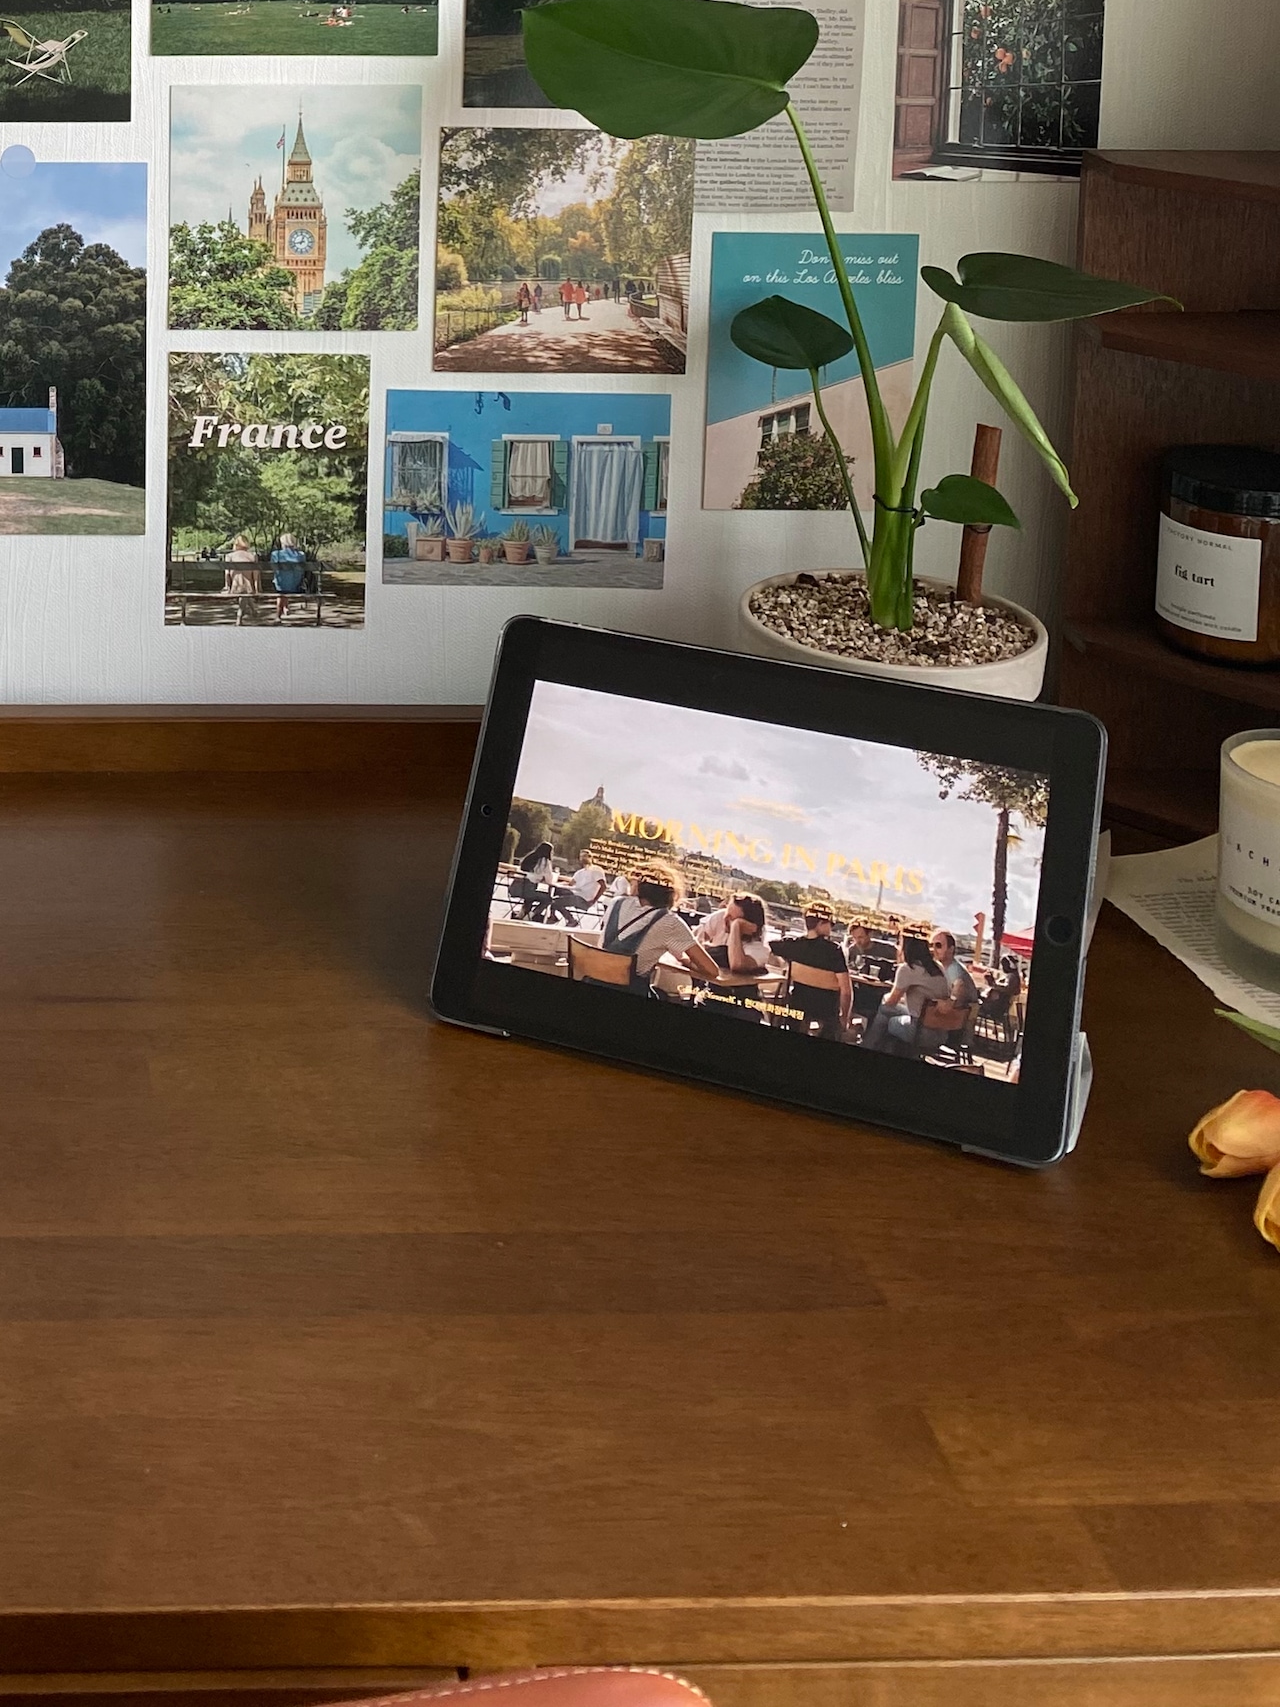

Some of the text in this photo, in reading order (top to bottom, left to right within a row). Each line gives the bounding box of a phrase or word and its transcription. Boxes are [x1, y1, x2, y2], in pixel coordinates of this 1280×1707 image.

[844, 253, 874, 265] miss
[877, 253, 900, 265] out
[742, 274, 762, 283] on
[766, 270, 790, 284] this
[793, 269, 820, 284] Los
[876, 269, 904, 284] bliss
[188, 415, 347, 450] France
[1174, 564, 1215, 588] fig tart
[609, 809, 772, 863] MORNING
[781, 843, 818, 872] IN
[825, 851, 924, 895] PARIS
